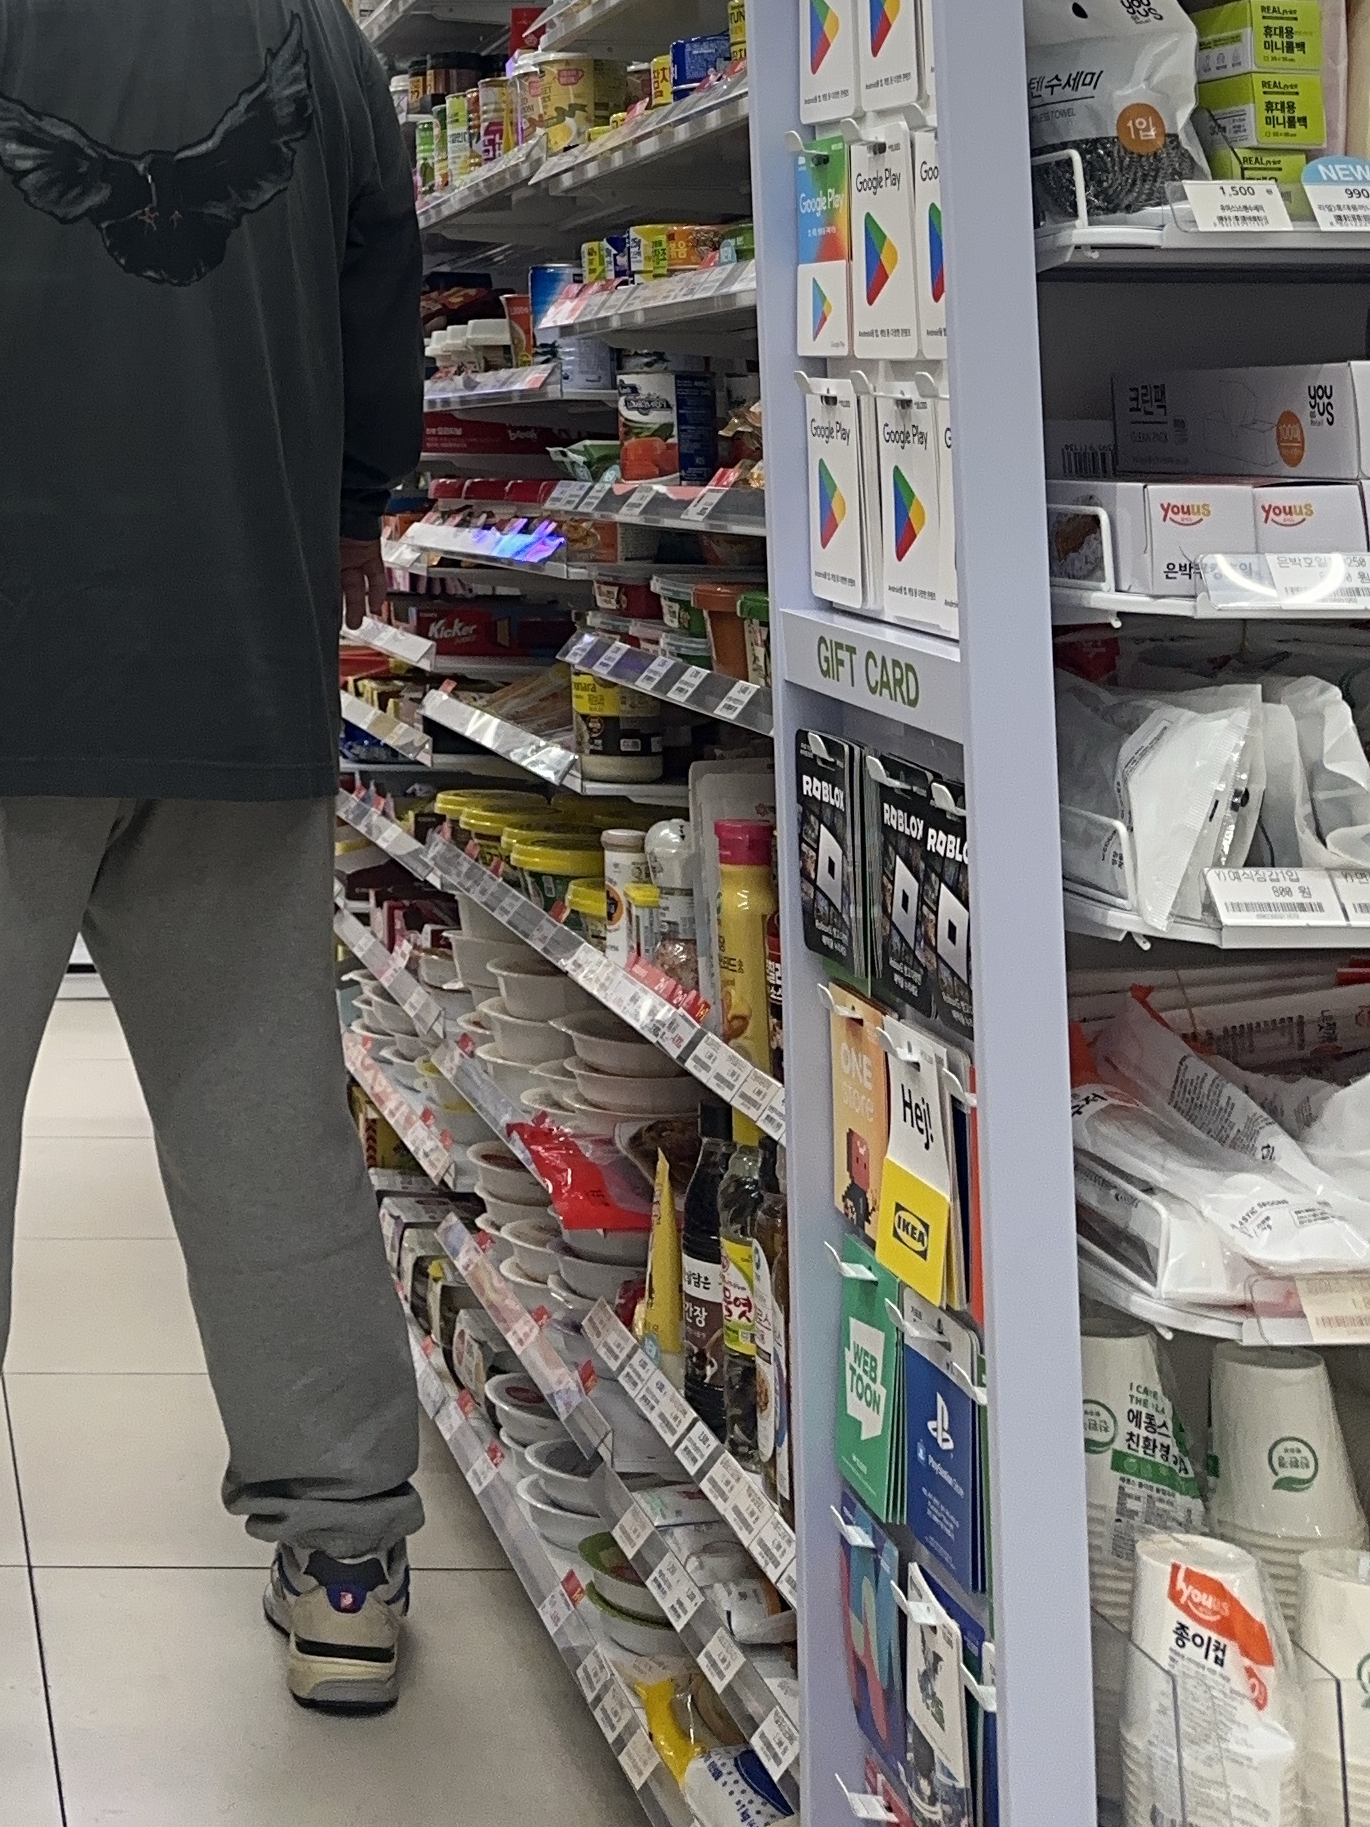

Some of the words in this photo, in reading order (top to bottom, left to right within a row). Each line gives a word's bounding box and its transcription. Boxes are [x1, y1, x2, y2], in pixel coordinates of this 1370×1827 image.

[1260, 5, 1281, 16] REAL
[1030, 69, 1104, 99] 텐수세미
[1126, 114, 1157, 141] 1입
[855, 173, 884, 196] Google
[884, 168, 901, 191] Play
[1219, 185, 1256, 197] 1,500
[799, 191, 827, 217] Google
[1128, 383, 1168, 416] 크린팩
[810, 418, 835, 445] Google
[835, 420, 851, 446] Play
[882, 423, 911, 450] Google
[912, 424, 928, 450] Play
[1160, 502, 1212, 523] youus
[1260, 503, 1315, 524] youus
[816, 635, 857, 688] GIFT
[864, 652, 920, 709] CARD
[802, 774, 845, 812] ROBLOX
[883, 802, 924, 841] ROBLOX
[926, 827, 969, 865] ROBLO
[839, 1042, 873, 1091] ONE
[841, 1081, 875, 1123] store
[900, 1083, 934, 1151] Hej!
[896, 1213, 927, 1248] IKEA
[852, 1340, 878, 1385] WEB
[848, 1364, 881, 1416] TOON
[1172, 1620, 1228, 1668] 종이컵
